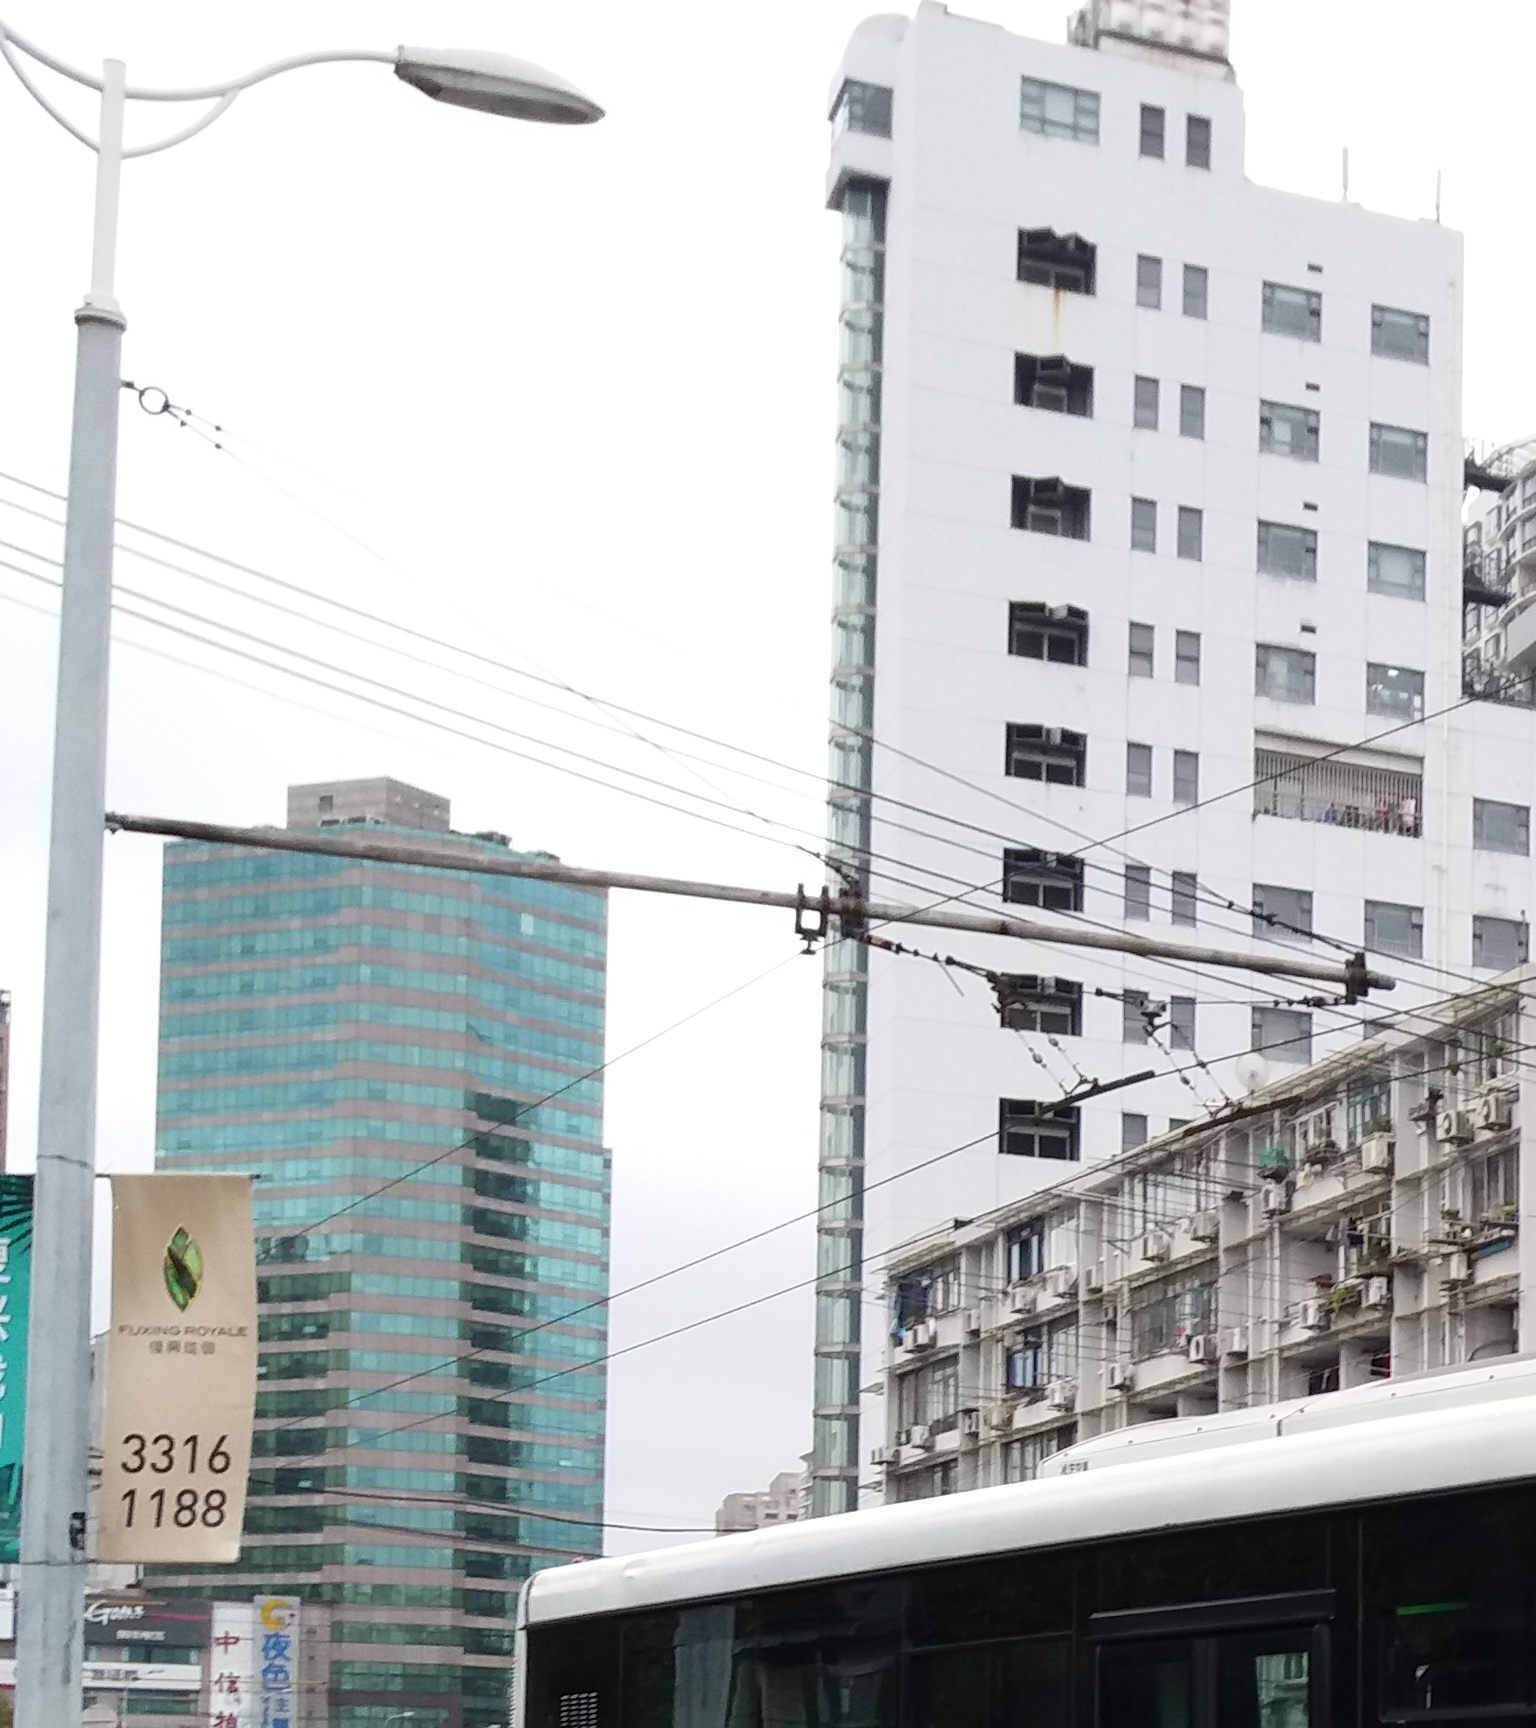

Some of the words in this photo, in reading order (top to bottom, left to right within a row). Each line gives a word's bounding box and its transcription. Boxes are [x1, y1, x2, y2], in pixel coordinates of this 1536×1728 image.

[121, 1433, 231, 1474] 3316
[121, 1488, 227, 1528] 1188
[261, 1631, 291, 1691] 夜色
